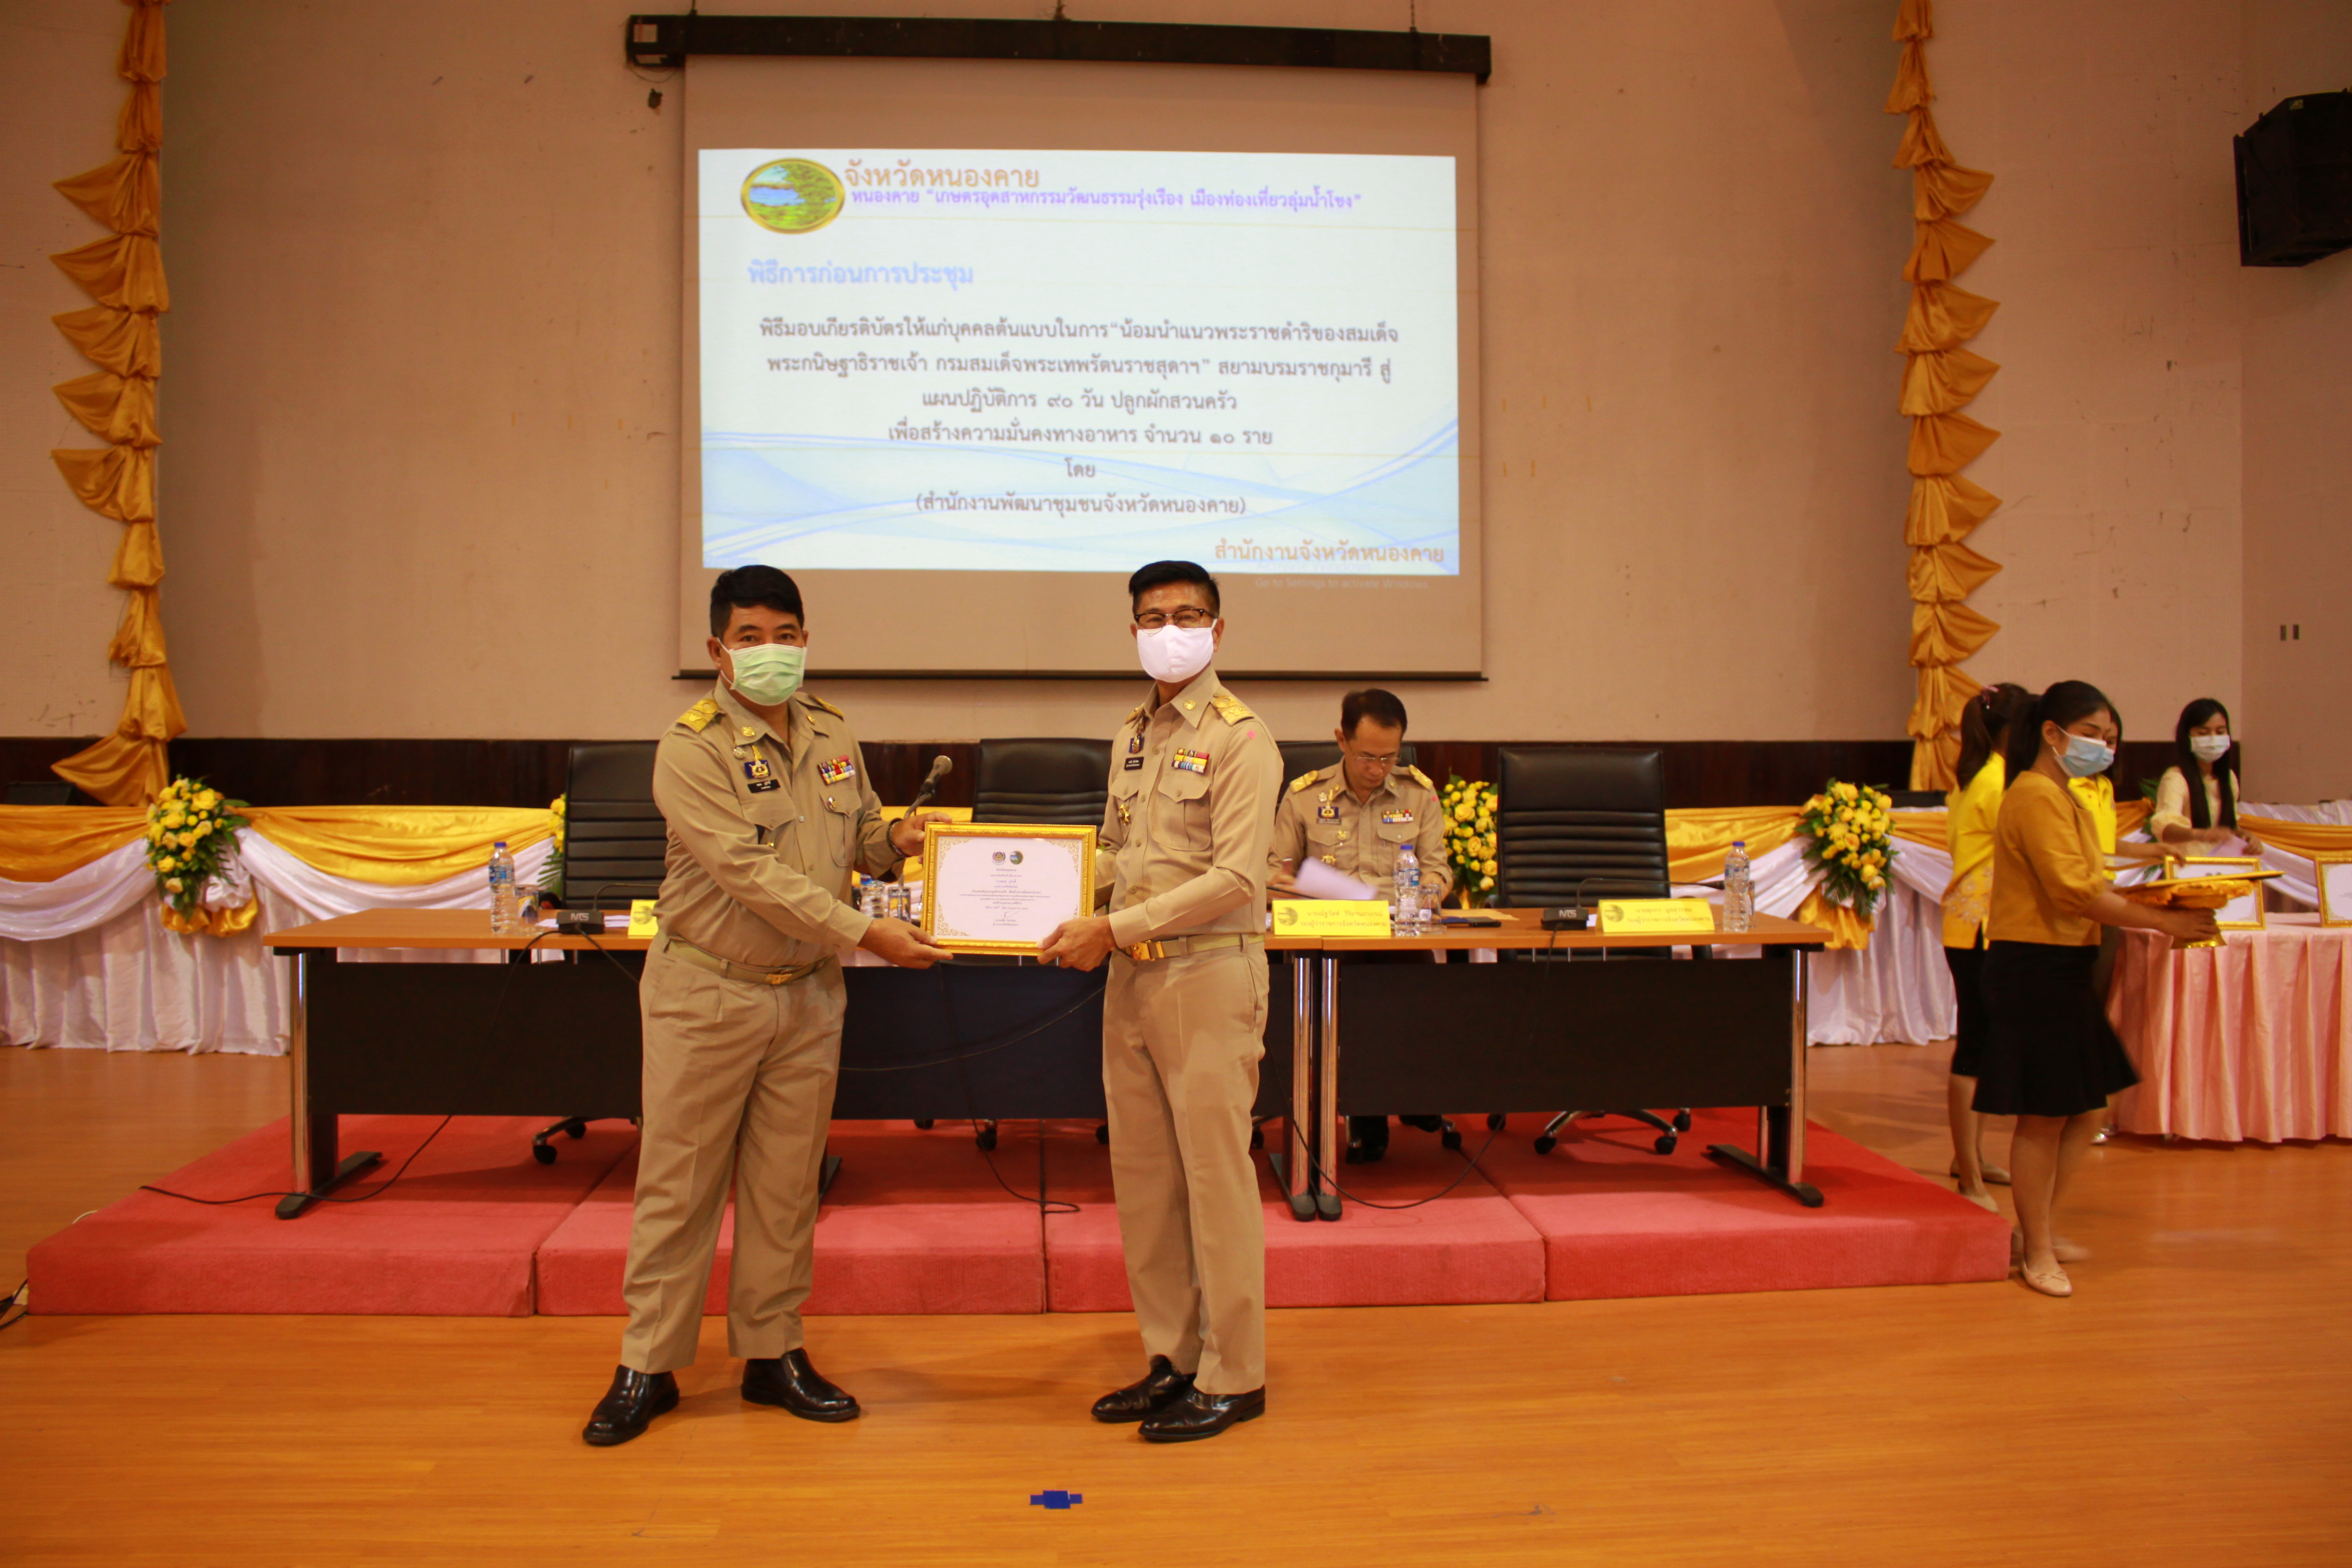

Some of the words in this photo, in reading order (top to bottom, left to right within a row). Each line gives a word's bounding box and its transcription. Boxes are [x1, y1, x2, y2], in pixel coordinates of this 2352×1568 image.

[844, 159, 1039, 188] จังหวัดหนองคาย
[851, 191, 920, 204] หนองคาย
[747, 258, 974, 291] พิธีการก่อนการประชุม
[767, 350, 928, 378] พระกนิษฐาธิราชเจ้า
[1218, 356, 1372, 383] สยามบรมราชกุมารี
[1380, 358, 1391, 384] สู่
[922, 386, 1037, 413] แผนปฏิบัติการ
[1047, 394, 1074, 408] ๙๐
[1080, 388, 1104, 408] วัน
[1110, 389, 1237, 415] ปลูกผักสวนครัว
[888, 417, 1137, 443] เพื่อสร้างความมั่นคงทางอาหาร
[1144, 423, 1202, 444] จำนวน
[1209, 434, 1235, 444] ๑๐
[1242, 430, 1273, 445] ราย
[1064, 457, 1096, 478] โดย
[916, 490, 1246, 518] (สำนักงานพัฒนาชุมชนจังหวัดหนองคาย)
[1215, 538, 1444, 563] สำนักงานจังหวัดหนองคาย
[1256, 578, 1270, 588] Go
[1274, 578, 1284, 588] to
[1286, 578, 1325, 590] Settings
